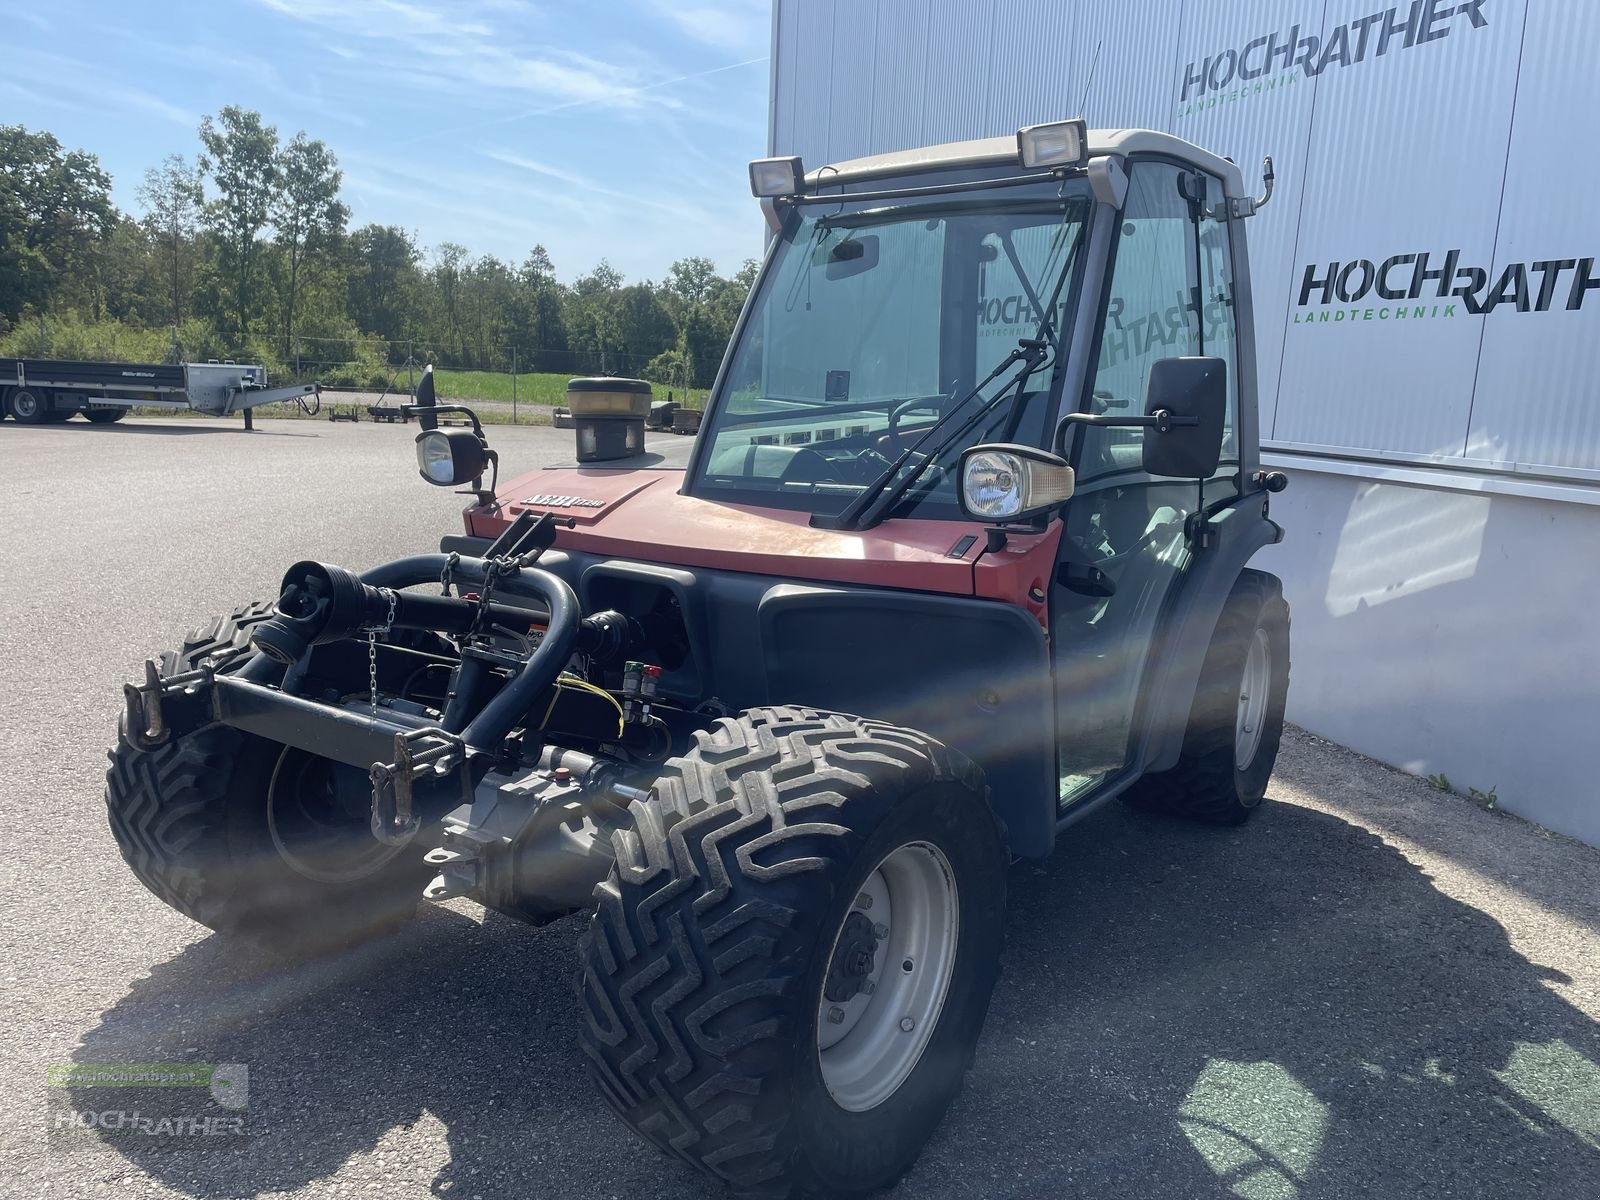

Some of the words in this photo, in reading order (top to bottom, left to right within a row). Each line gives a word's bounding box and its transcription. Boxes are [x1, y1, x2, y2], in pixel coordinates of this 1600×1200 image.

[1181, 0, 1489, 101] HOCHRATHER
[1177, 71, 1299, 118] LANDTECHNIK
[1294, 304, 1457, 323] LANDTECHNIK
